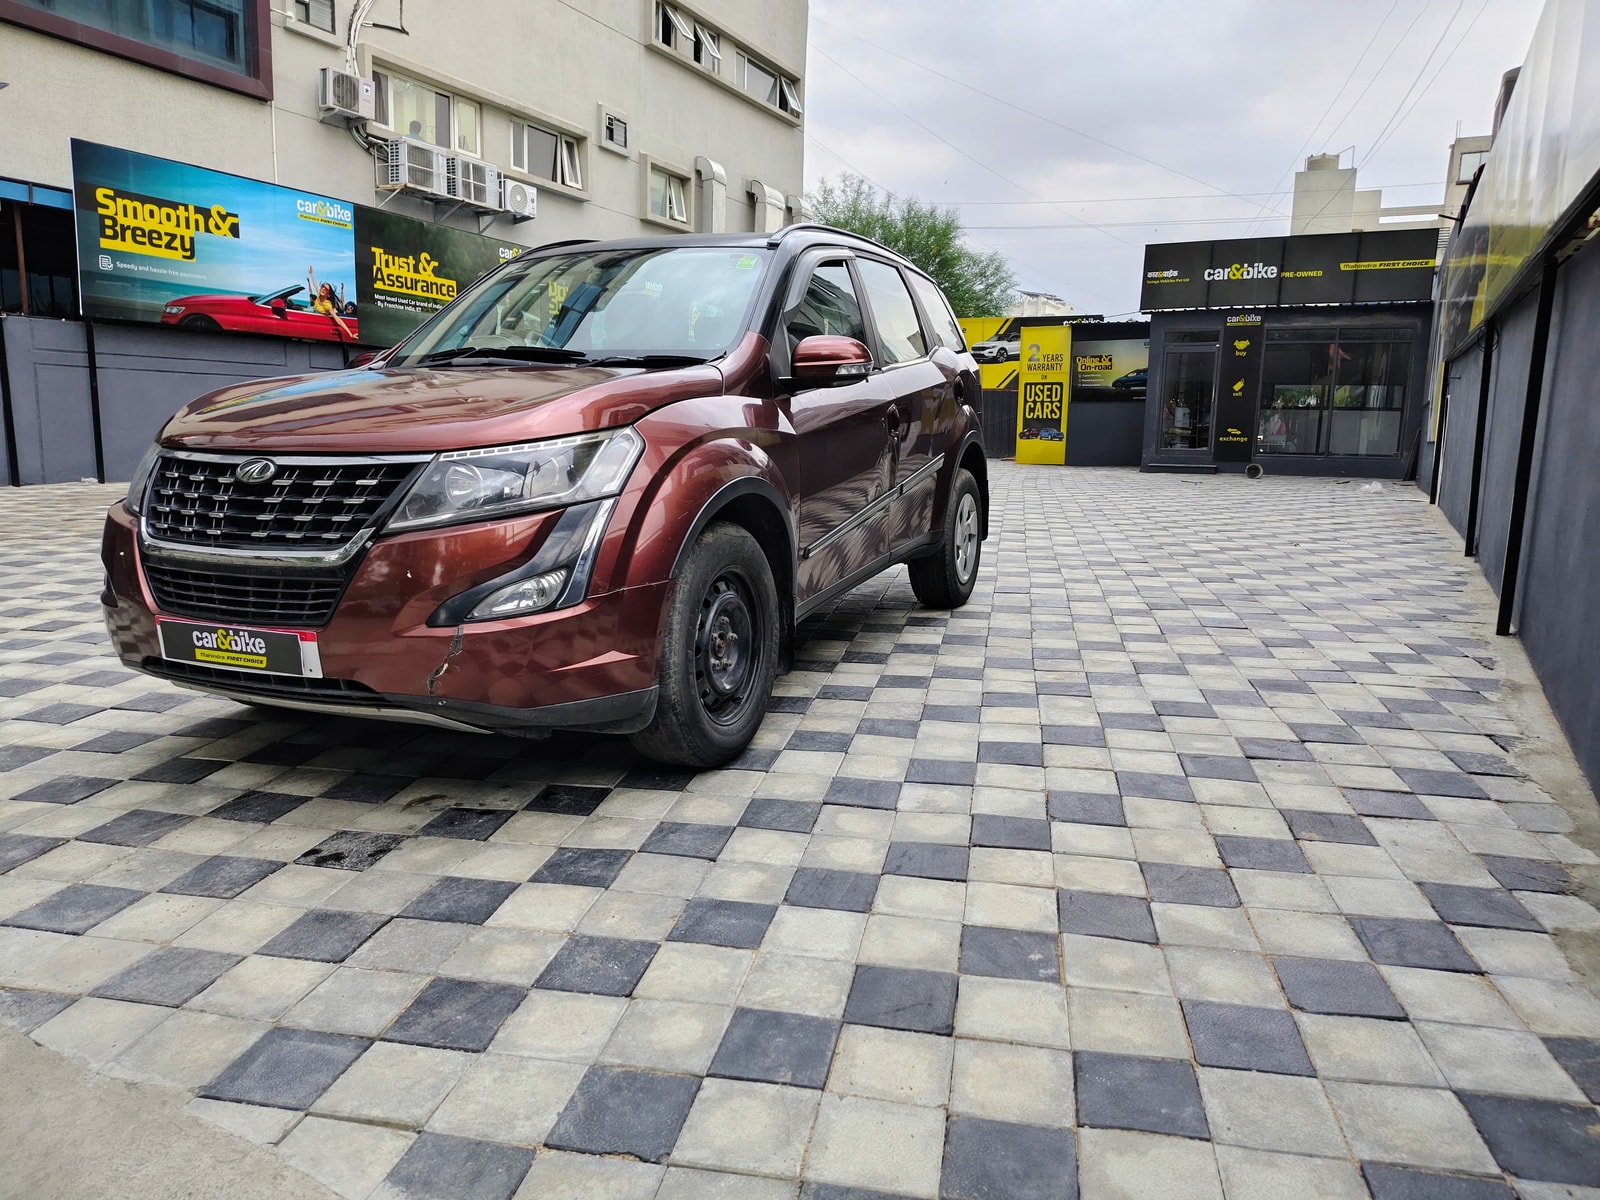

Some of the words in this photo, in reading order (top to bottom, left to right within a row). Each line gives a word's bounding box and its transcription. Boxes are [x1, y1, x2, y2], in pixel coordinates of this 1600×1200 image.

[96, 187, 204, 233] Smooth
[208, 204, 239, 238] &
[296, 199, 352, 222] car&bike
[98, 214, 195, 260] Breezy
[116, 261, 138, 272] Speedy
[150, 266, 179, 276] hassle-free
[371, 246, 415, 274] Trust
[418, 252, 439, 277] &
[1204, 262, 1278, 281] car&bike
[1281, 270, 1323, 278] PRE-OWNED
[374, 266, 455, 298] Assurance
[384, 302, 404, 311] Franchise
[386, 295, 398, 303] loved
[398, 296, 408, 304] Used
[416, 299, 428, 307] brand
[1227, 314, 1262, 322] car&bike
[1027, 343, 1040, 362] 2
[1042, 354, 1064, 362] YEARS
[1076, 356, 1100, 364] Online
[1101, 353, 1112, 363] &
[1027, 362, 1063, 371] WARRANTY
[1026, 385, 1060, 402] USED
[1026, 402, 1060, 419] CARS
[192, 629, 266, 653] car&bike
[226, 655, 243, 663] FIRST
[243, 657, 264, 665] CHOICE
